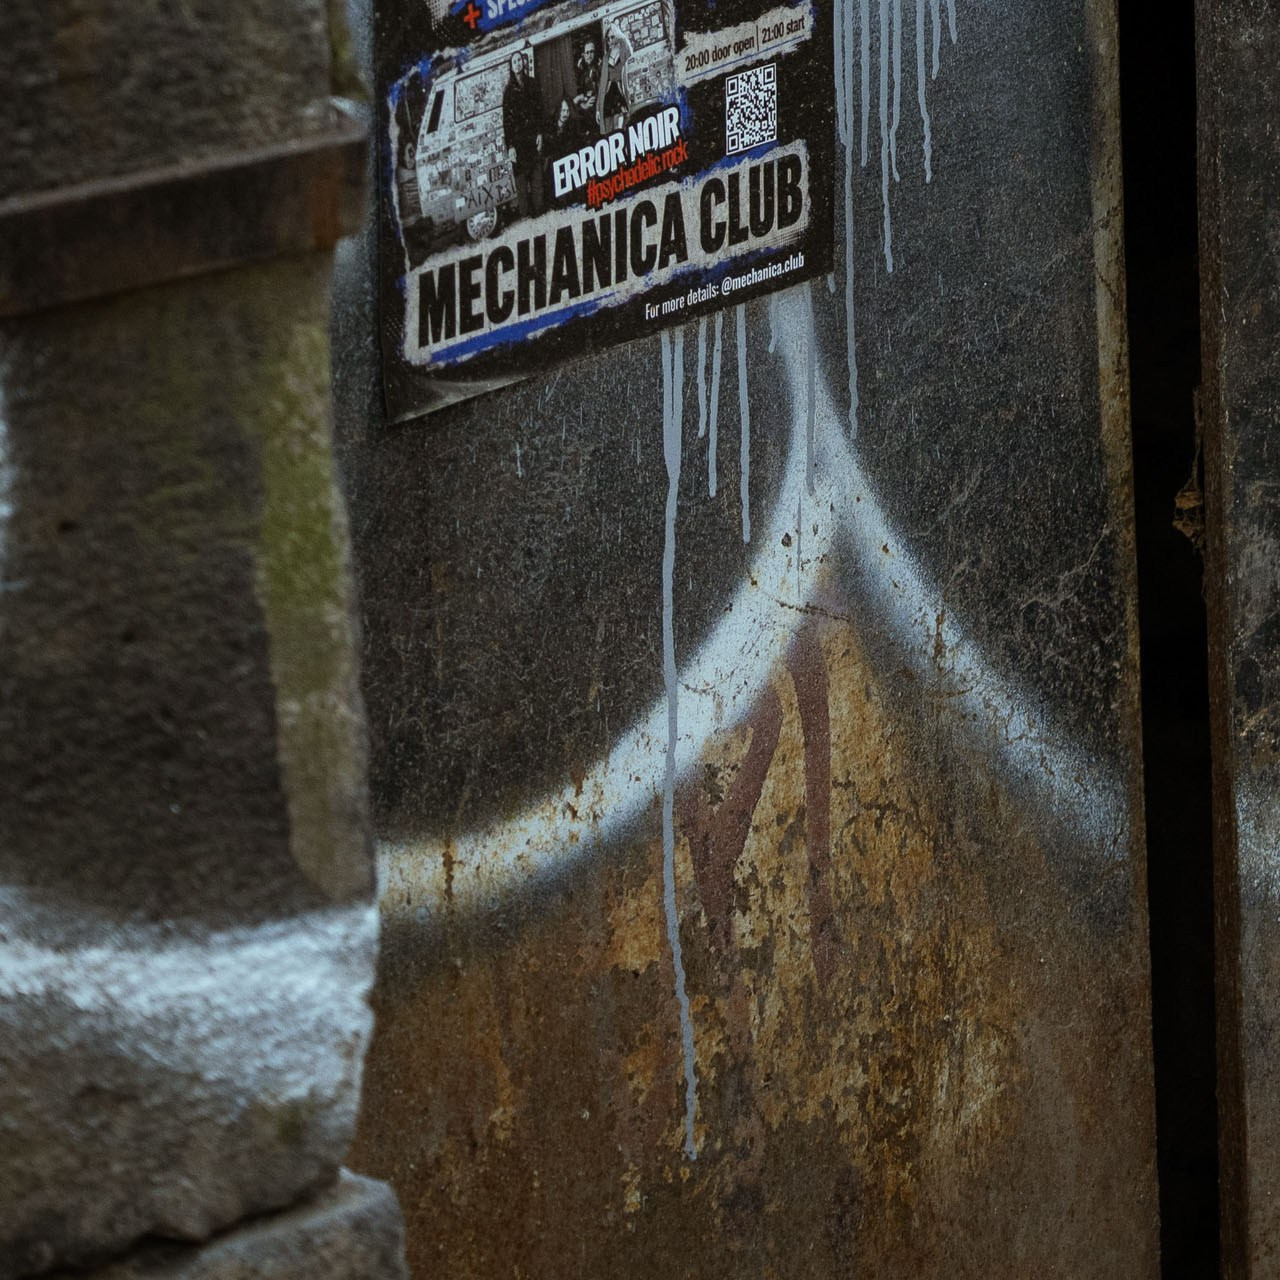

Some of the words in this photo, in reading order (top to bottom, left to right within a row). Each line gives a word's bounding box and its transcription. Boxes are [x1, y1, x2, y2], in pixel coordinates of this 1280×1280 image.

[685, 50, 710, 73] 20:00
[712, 44, 731, 62] door
[733, 35, 755, 57] open
[761, 21, 785, 44] 21:00
[786, 15, 806, 35] start
[553, 130, 626, 198] ERROR
[630, 106, 680, 161] NOIR
[661, 138, 689, 171] rock
[417, 191, 689, 350] MECHANICA
[700, 152, 805, 255] CLUB
[645, 301, 659, 321] For
[662, 295, 686, 317] more
[687, 284, 720, 311] details:
[721, 251, 806, 297] @mechanica.club
